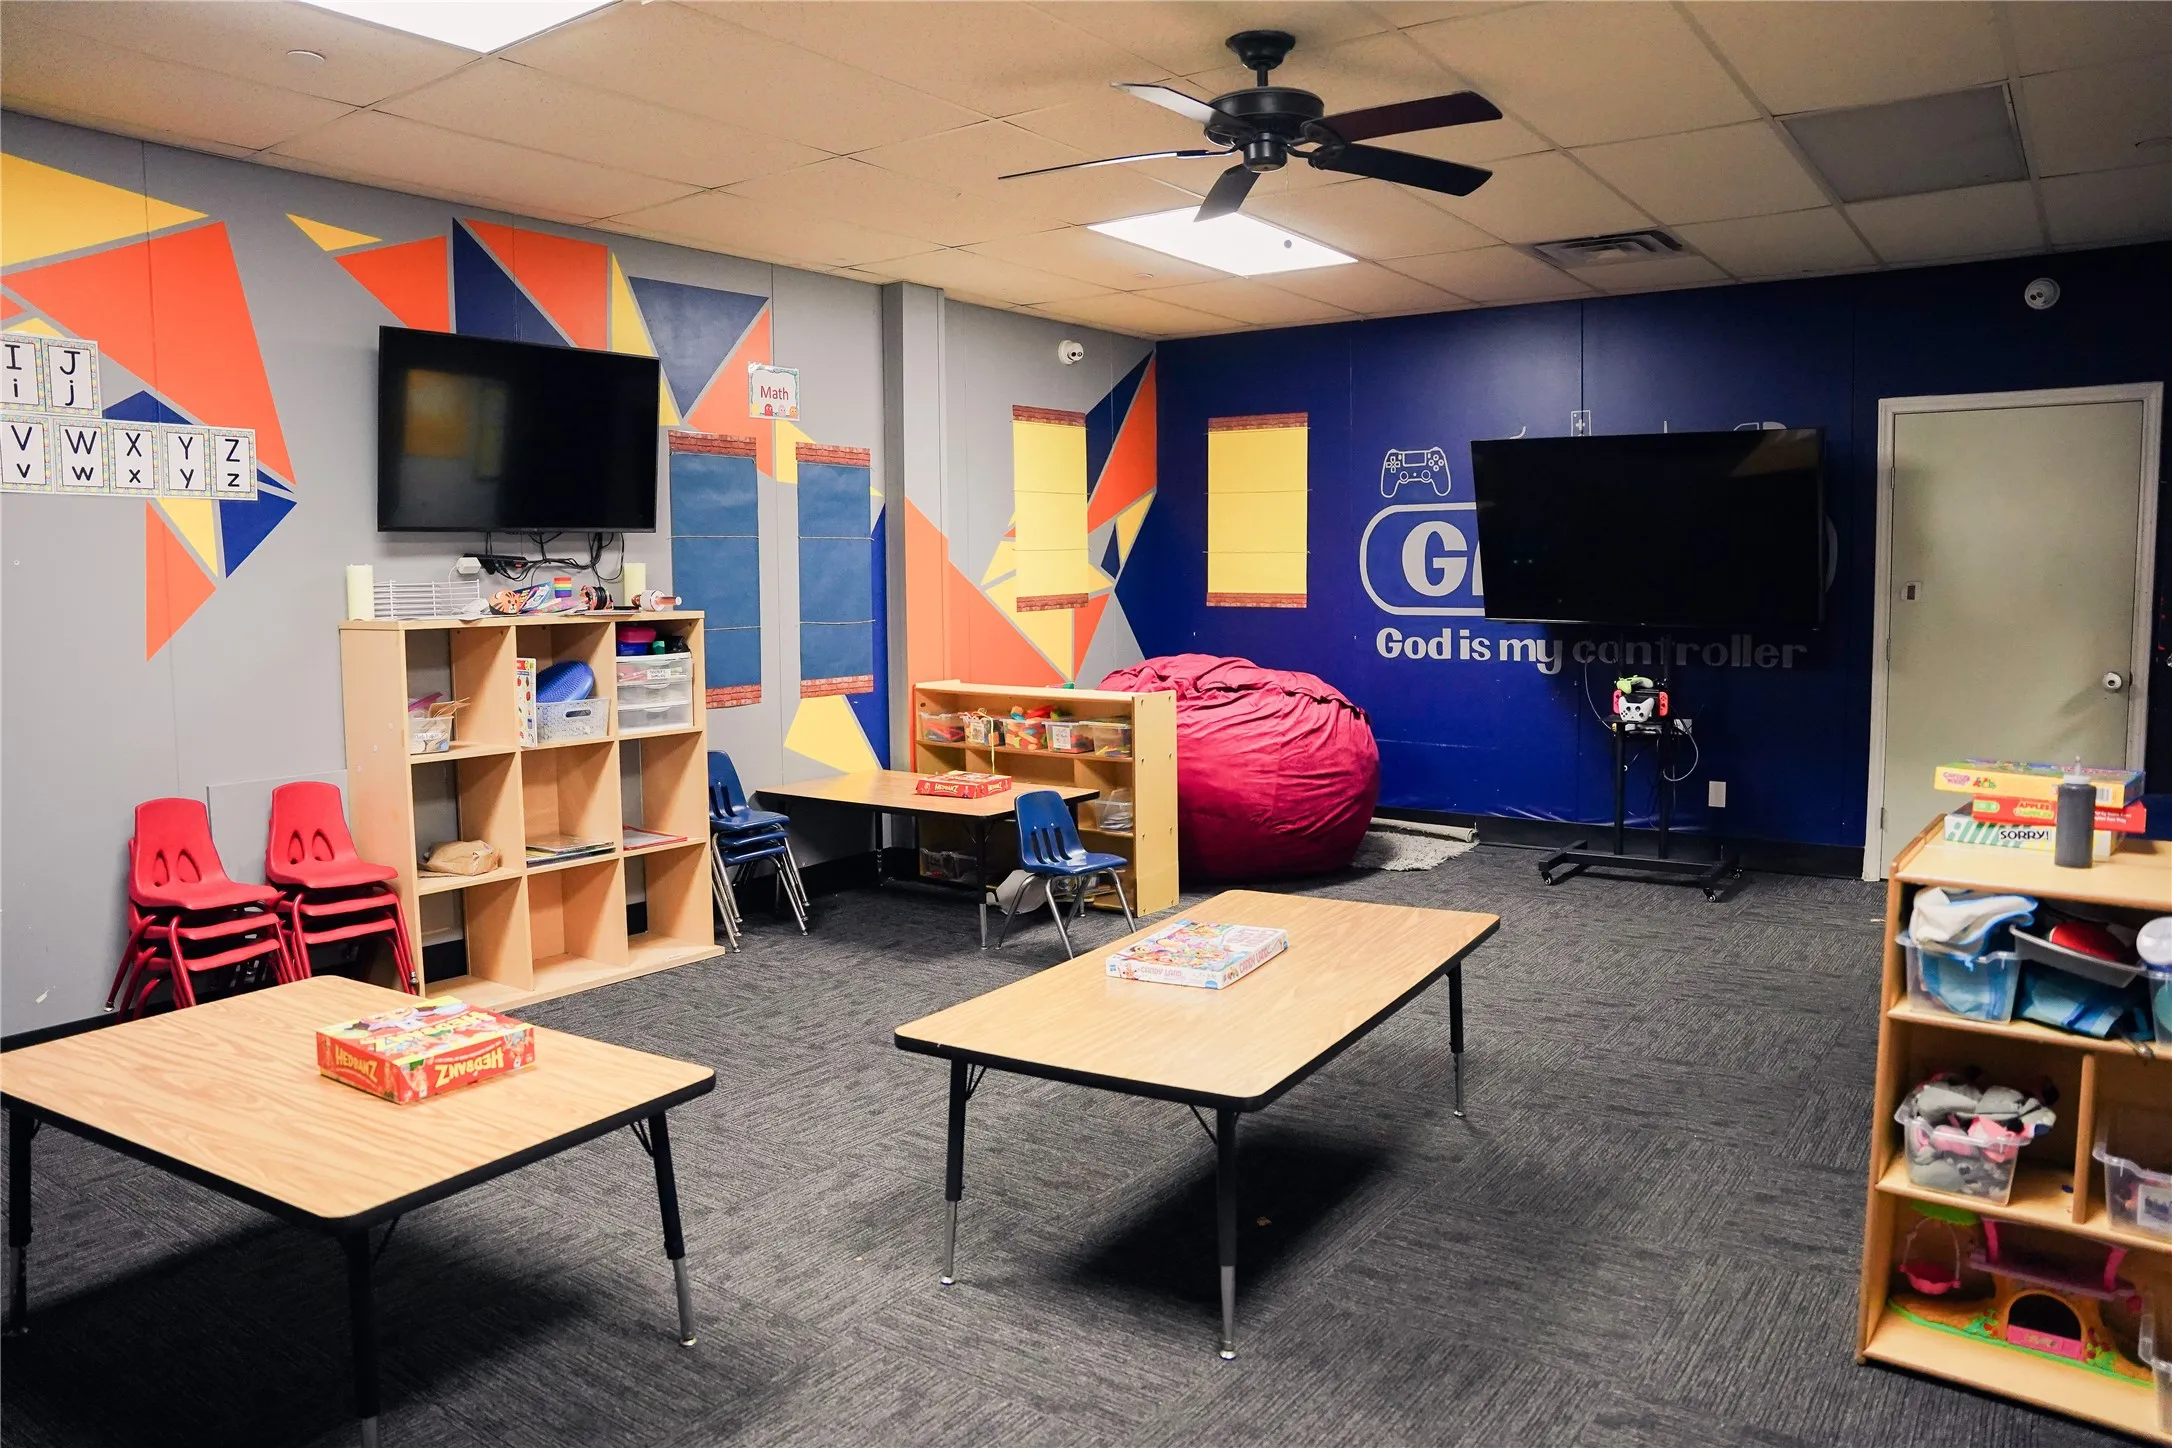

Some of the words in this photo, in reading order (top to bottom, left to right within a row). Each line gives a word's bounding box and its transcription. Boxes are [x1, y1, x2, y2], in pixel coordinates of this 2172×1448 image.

[5, 344, 22, 370] I
[59, 350, 81, 375] J
[13, 378, 19, 397] i
[64, 380, 74, 406] j
[760, 385, 789, 401] Math
[11, 425, 33, 451] V
[65, 429, 97, 455] W
[125, 432, 142, 457] X
[178, 435, 194, 460] Y
[225, 438, 240, 462] Z
[16, 463, 31, 479] v
[72, 466, 94, 481] w
[128, 469, 141, 483] x
[180, 468, 194, 488] y
[227, 472, 240, 487] z
[1376, 627, 1452, 660] God
[1459, 634, 1492, 661] is
[1499, 638, 1564, 675] my
[2000, 830, 2049, 840] SORRY!
[335, 1044, 379, 1085] HEDBANZ
[434, 1046, 504, 1089] HEDBANZ
